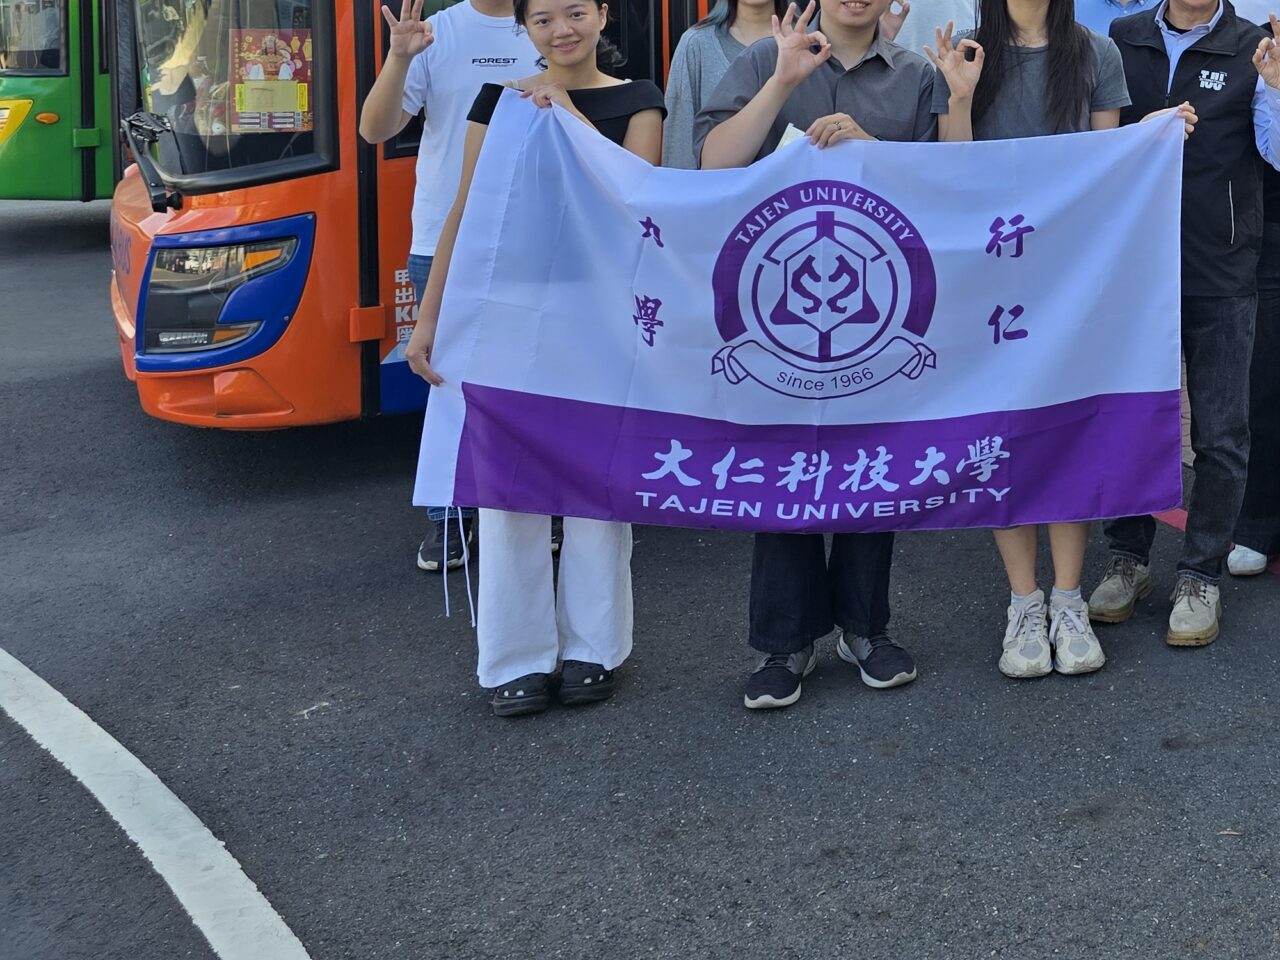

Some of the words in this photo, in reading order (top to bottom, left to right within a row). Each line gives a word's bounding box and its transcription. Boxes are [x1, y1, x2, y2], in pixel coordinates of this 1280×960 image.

[734, 197, 790, 245] TAJEN
[799, 186, 915, 242] UNIVERSITY
[395, 287, 417, 304] 出
[776, 371, 824, 391] since
[831, 367, 875, 389] 1966
[642, 436, 1011, 500] 大仁科技大學
[635, 491, 763, 519] TAJEN
[777, 486, 1012, 520] UNIVERSITY
